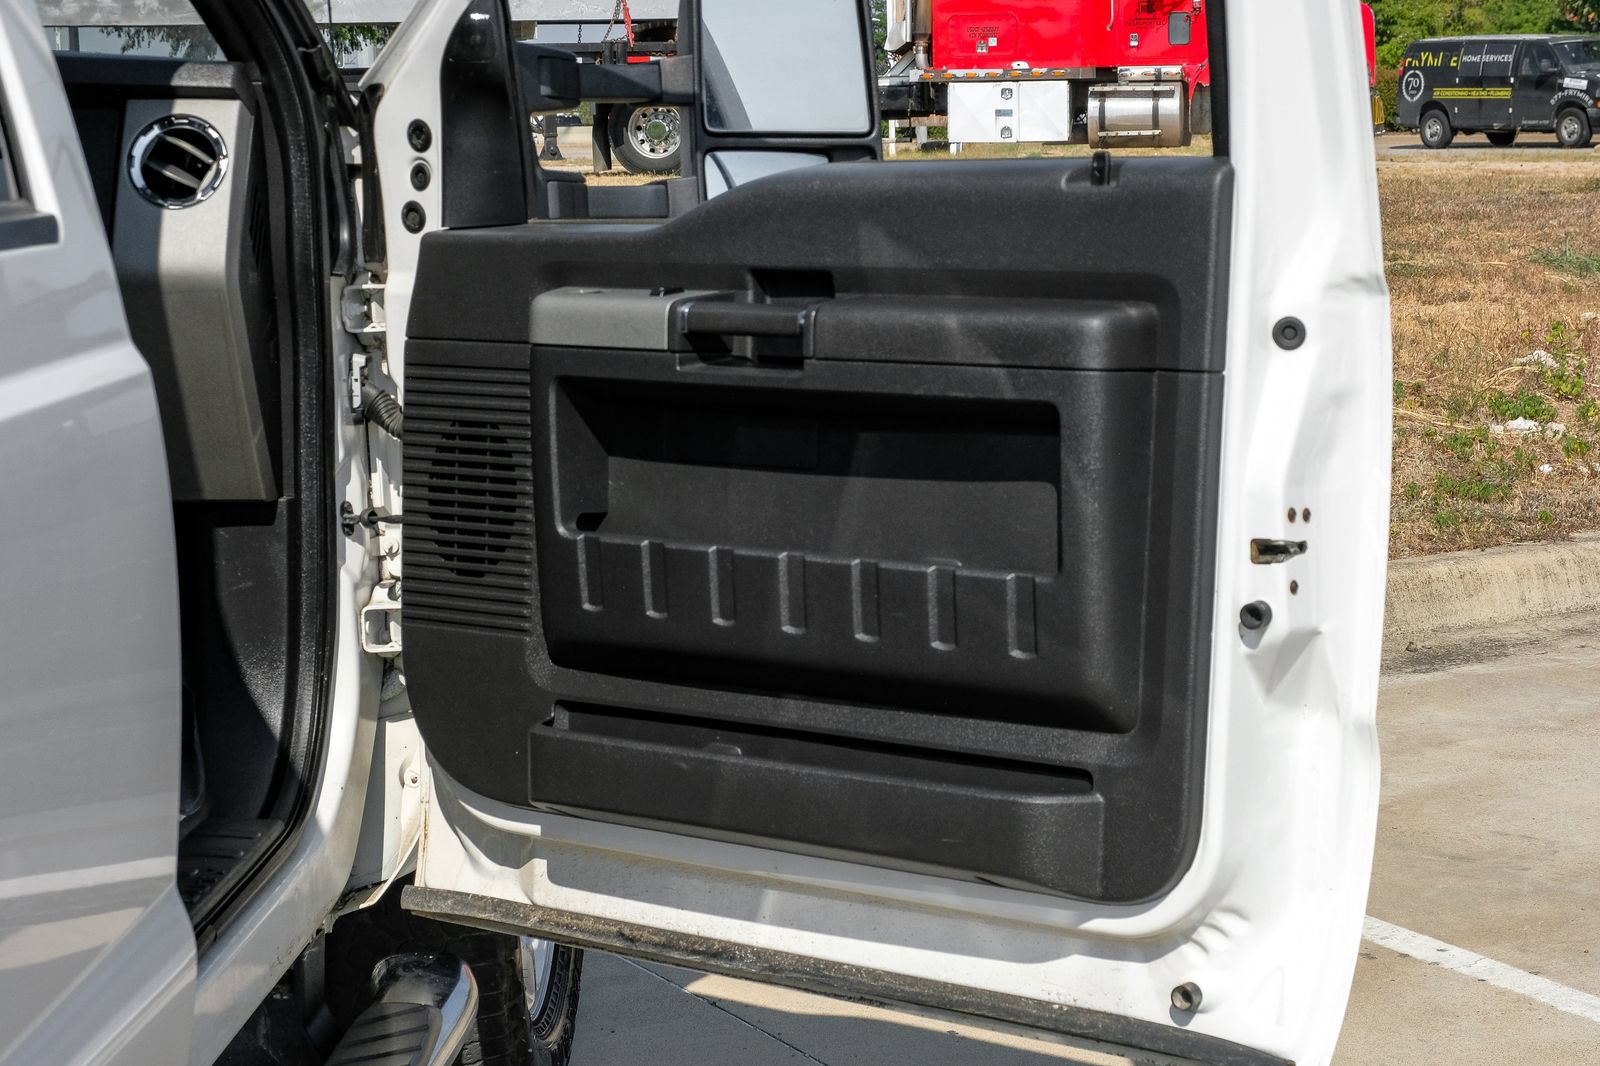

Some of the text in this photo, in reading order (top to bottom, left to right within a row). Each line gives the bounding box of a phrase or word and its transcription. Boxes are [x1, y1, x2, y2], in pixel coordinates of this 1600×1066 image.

[1405, 51, 1513, 67] FRYMIE HOME SERVICES
[1407, 77, 1420, 90] 70
